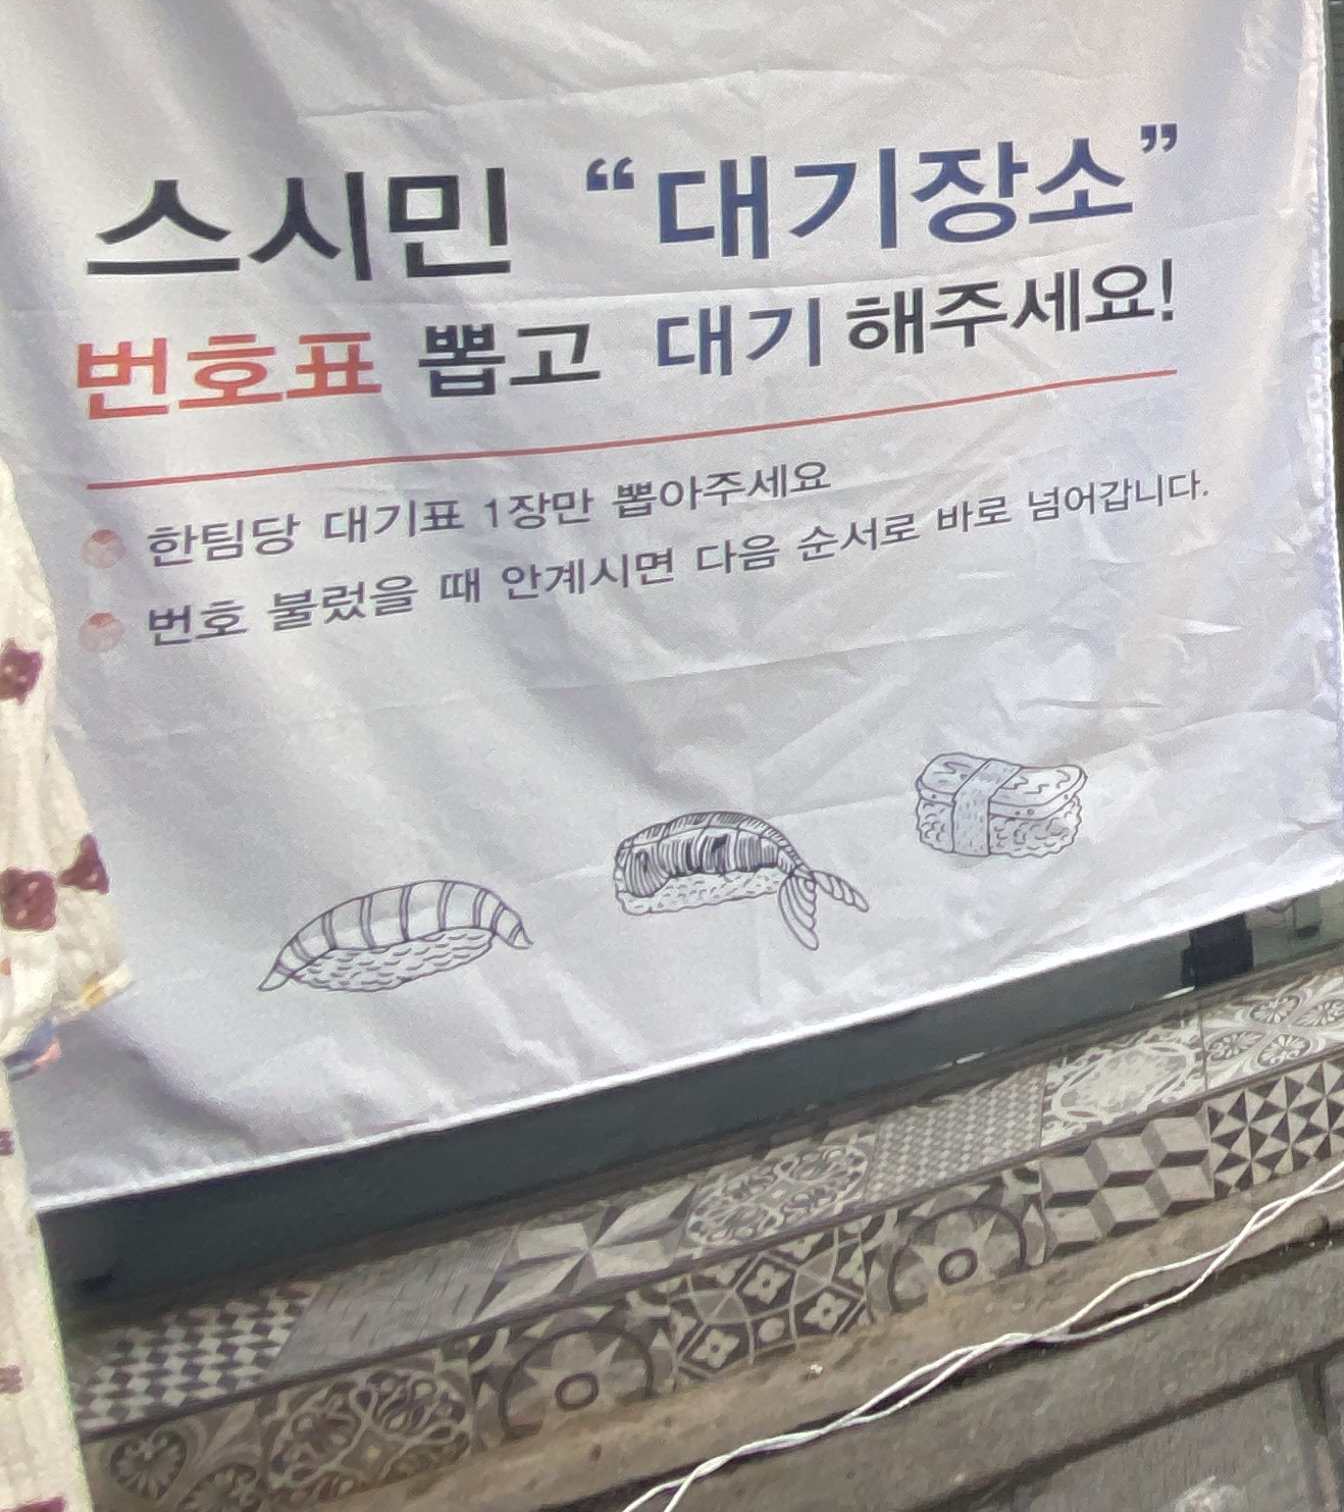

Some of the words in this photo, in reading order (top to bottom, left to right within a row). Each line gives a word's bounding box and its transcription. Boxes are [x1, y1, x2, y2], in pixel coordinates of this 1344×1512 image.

[86, 167, 512, 282] 스시민
[76, 332, 383, 420] 번호표
[417, 322, 601, 398] 뽑고
[656, 297, 822, 376] 대기
[845, 258, 1175, 354] 해주세요!
[147, 512, 301, 568] 한팀당
[323, 498, 464, 545] 대기표
[483, 488, 595, 531] 1장만
[611, 461, 833, 520] 뽑아주세요
[147, 601, 248, 647] 번호
[266, 574, 419, 632] 불렀을
[440, 567, 481, 604] 때
[501, 547, 676, 601] 안계시면
[695, 532, 781, 576] 다음
[796, 514, 921, 562] 순서로
[936, 496, 1012, 533] 바로
[1027, 469, 1211, 523] 넘어갑니다.
